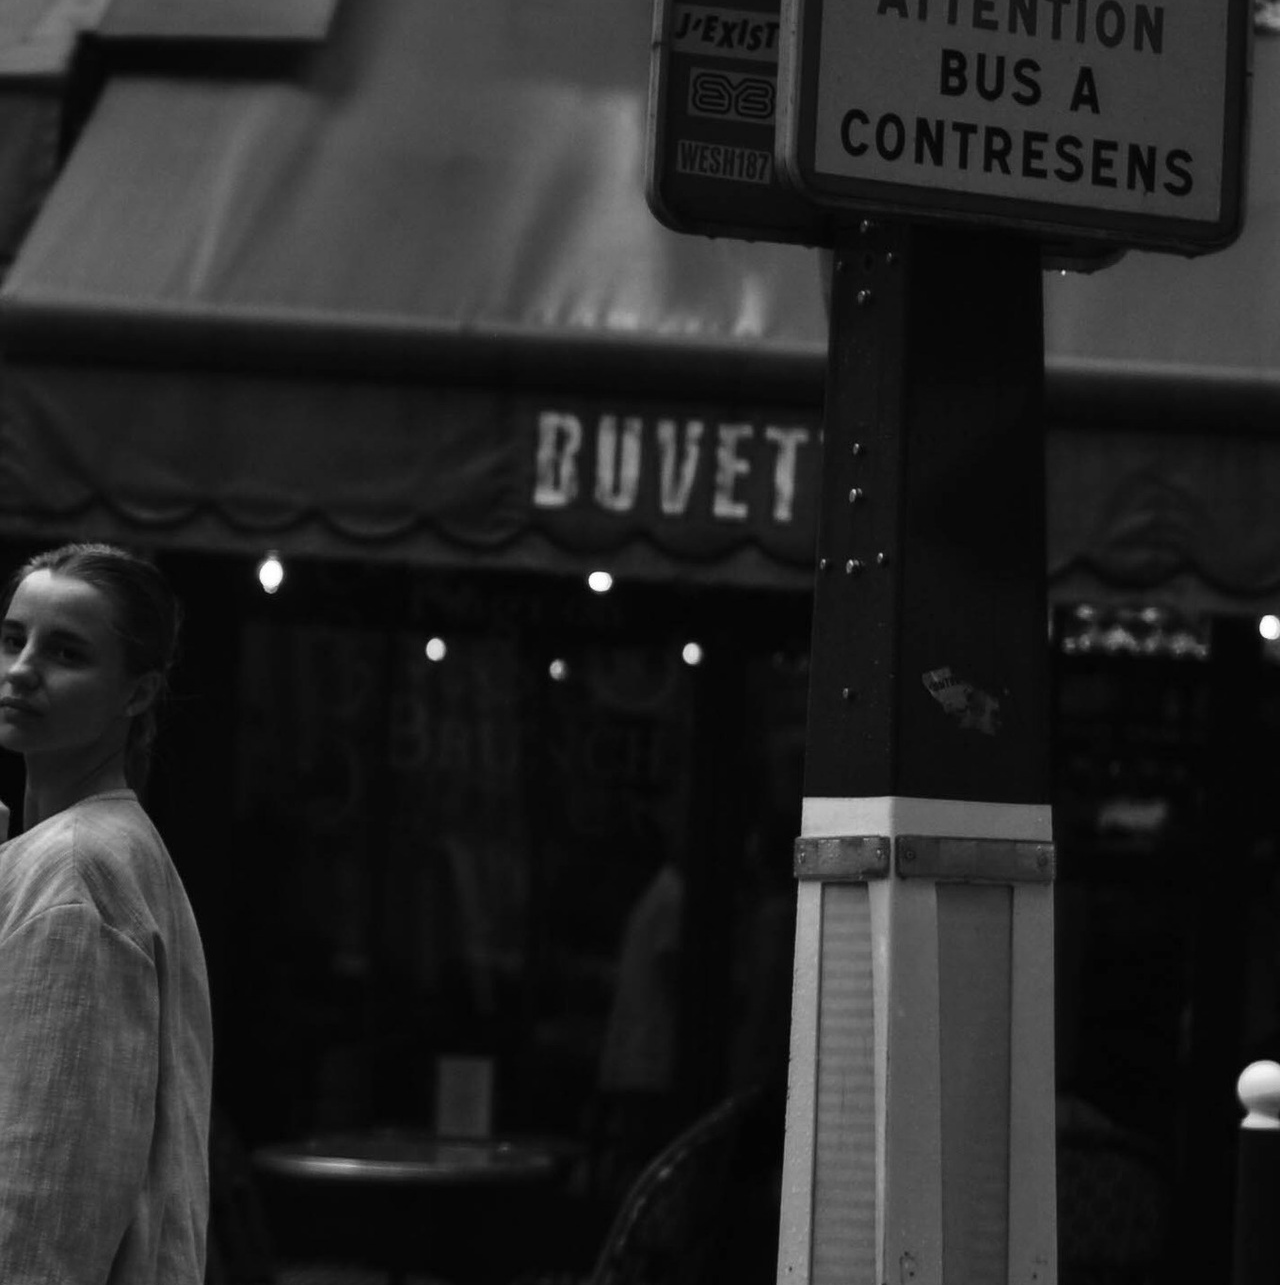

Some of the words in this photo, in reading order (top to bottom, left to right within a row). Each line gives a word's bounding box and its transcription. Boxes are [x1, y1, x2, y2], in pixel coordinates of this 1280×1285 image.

[939, 48, 1043, 107] BUS
[1069, 66, 1101, 115] A
[681, 142, 769, 181] WESH187
[840, 108, 1195, 197] CONTRESENS
[532, 410, 824, 523] BUVET
